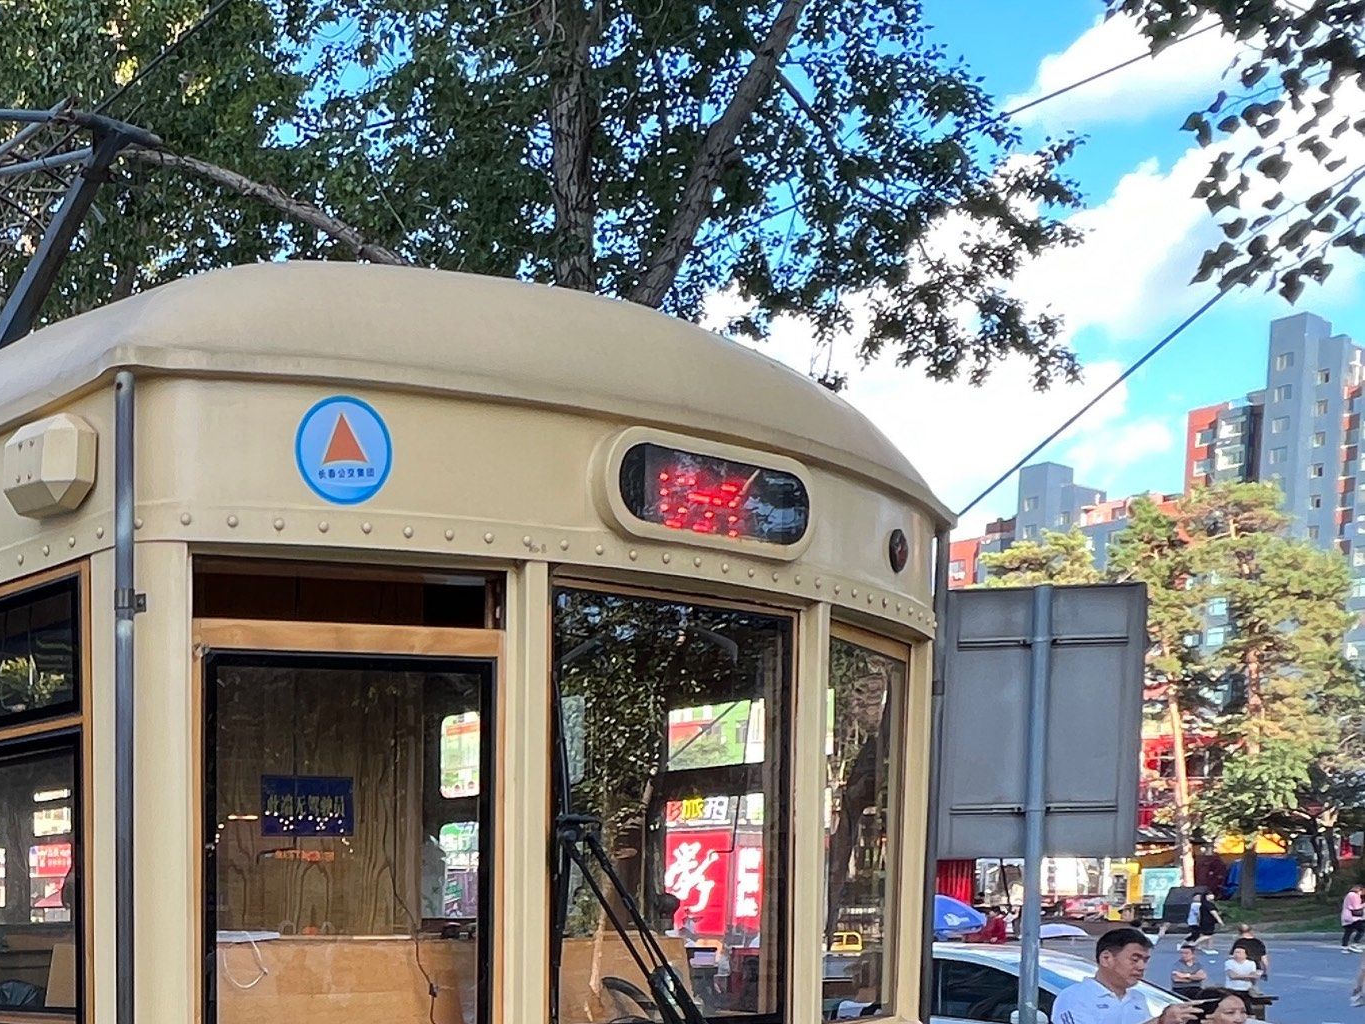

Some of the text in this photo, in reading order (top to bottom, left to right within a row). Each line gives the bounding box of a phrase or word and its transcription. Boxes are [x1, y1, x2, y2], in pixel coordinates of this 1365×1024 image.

[317, 467, 375, 480] 长春公交集团
